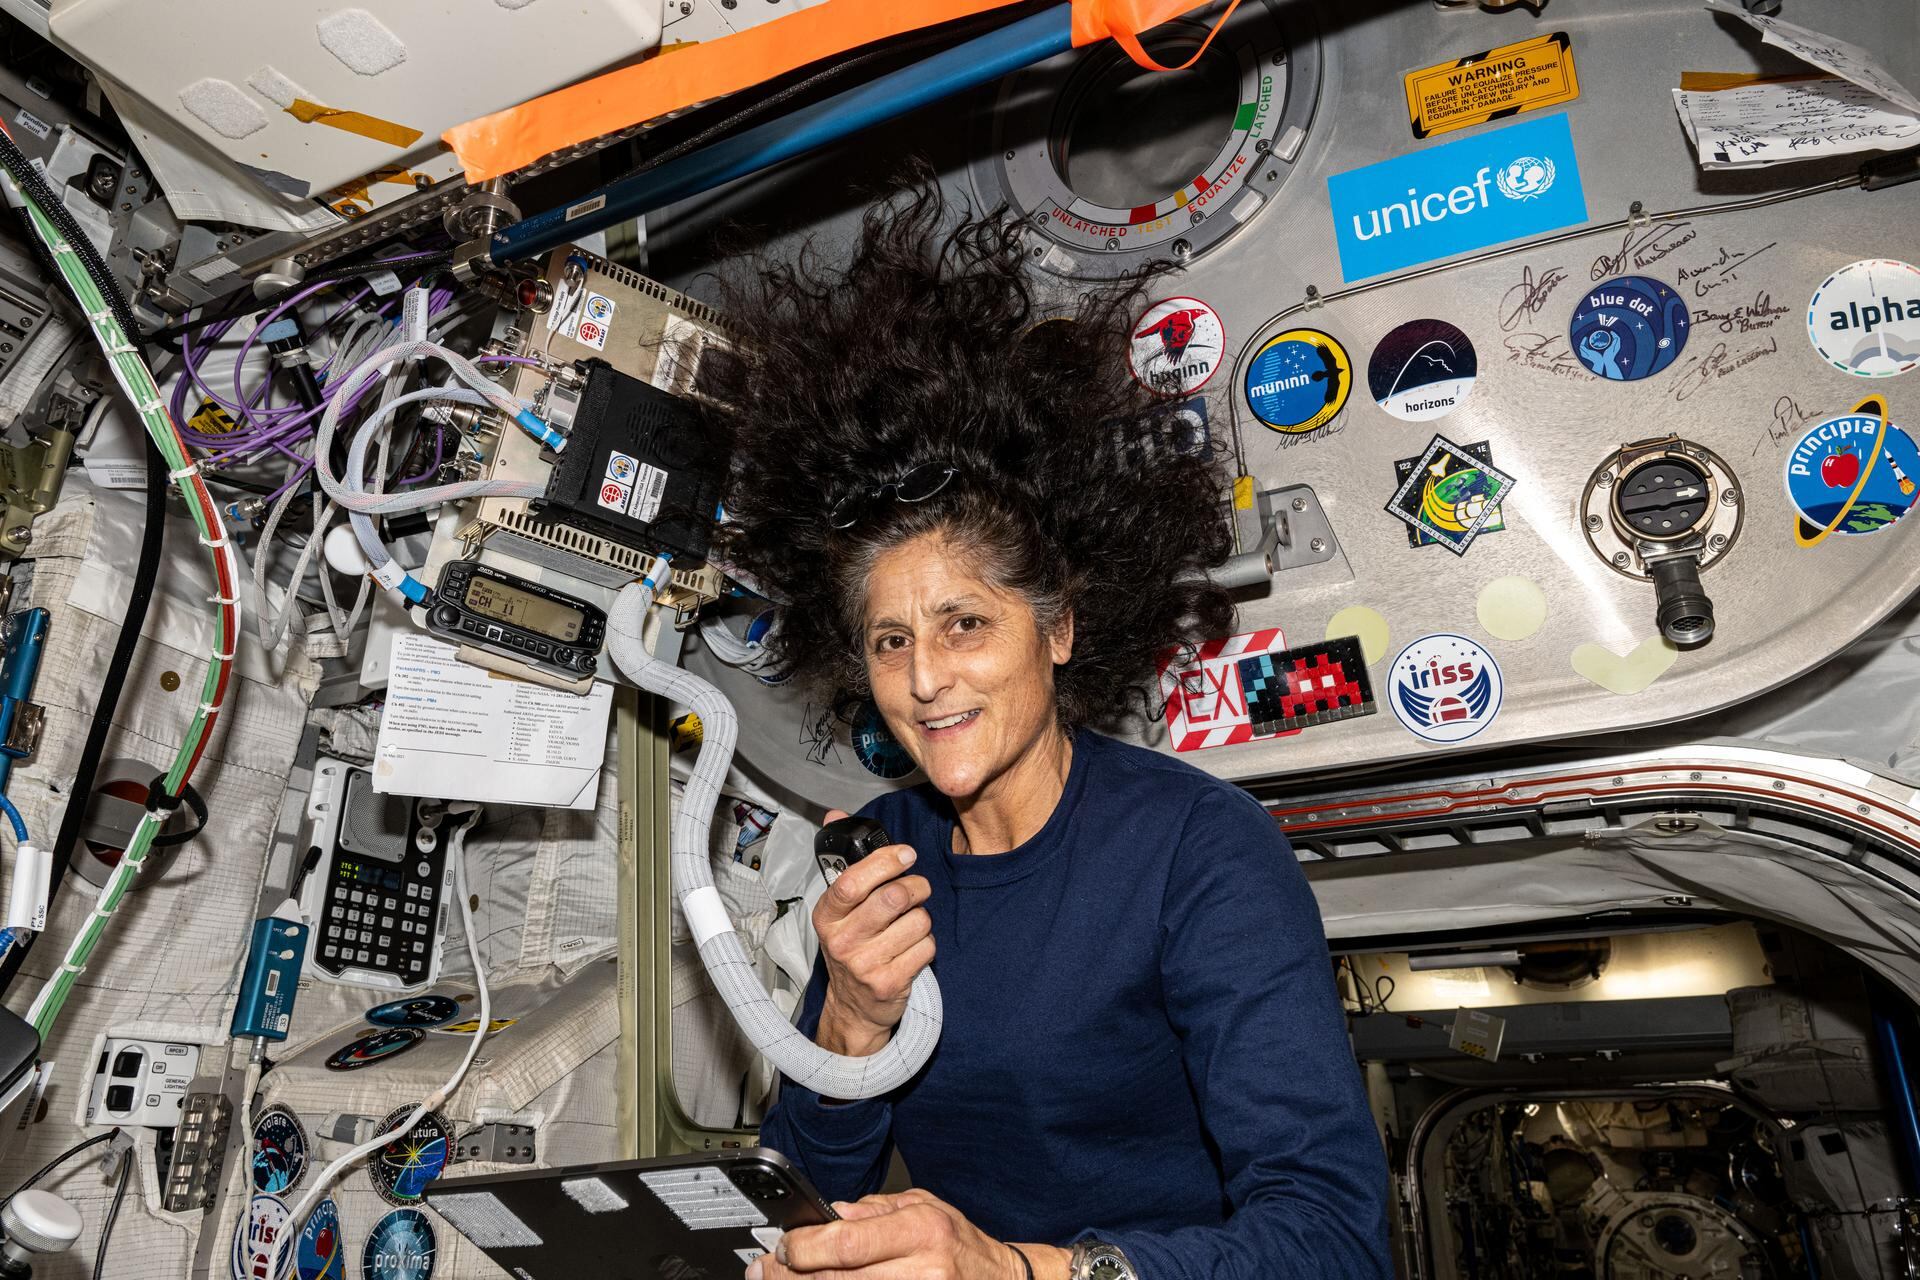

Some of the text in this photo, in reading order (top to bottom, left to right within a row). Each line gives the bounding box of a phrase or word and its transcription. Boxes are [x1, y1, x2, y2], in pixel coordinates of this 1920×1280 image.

[1424, 88, 1456, 102] FAILURE
[1472, 73, 1512, 88] EQUALIZE
[1514, 61, 1558, 77] PRESSURE
[1447, 56, 1526, 86] WARNING
[1425, 74, 1535, 108] BEFORE UNLATCHING CAN
[1426, 101, 1458, 114] RESULT
[1470, 91, 1497, 102] CREW
[1499, 82, 1528, 95] INJURY
[1532, 77, 1550, 86] AND
[1249, 75, 1273, 138] LATCHED
[1427, 93, 1516, 121] EQUIPMENT DAMAGE.
[21, 112, 49, 132] Bonding
[23, 121, 41, 135] Point
[1052, 154, 1247, 236] UNLATCHED TEST EQUALIZE
[1353, 168, 1493, 240] unicef
[1590, 294, 1653, 317] blue dot
[1830, 296, 1920, 333] alpha
[1150, 361, 1210, 385] huginn
[1251, 373, 1310, 398] muninn
[1404, 395, 1456, 414] horizons
[1477, 445, 1487, 453] 1E
[1790, 419, 1876, 476] principia
[1393, 444, 1439, 505] EYHARTS FRICK
[1399, 461, 1412, 471] 122
[1441, 441, 1507, 483] POINDEXTER
[620, 490, 629, 509] AMSAT
[1393, 507, 1457, 550] LOVE SCHLEGEL
[1460, 485, 1509, 549] MELVIN WALHEIM
[521, 581, 547, 594] KENWOOD
[479, 595, 492, 608] CH
[1409, 656, 1474, 690] iriss
[1179, 662, 1248, 724] EXI
[31, 917, 37, 927] P1
[279, 1017, 286, 1026] 33
[261, 1115, 287, 1132] volare
[408, 1128, 438, 1139] futura
[374, 1251, 431, 1273] proxima
